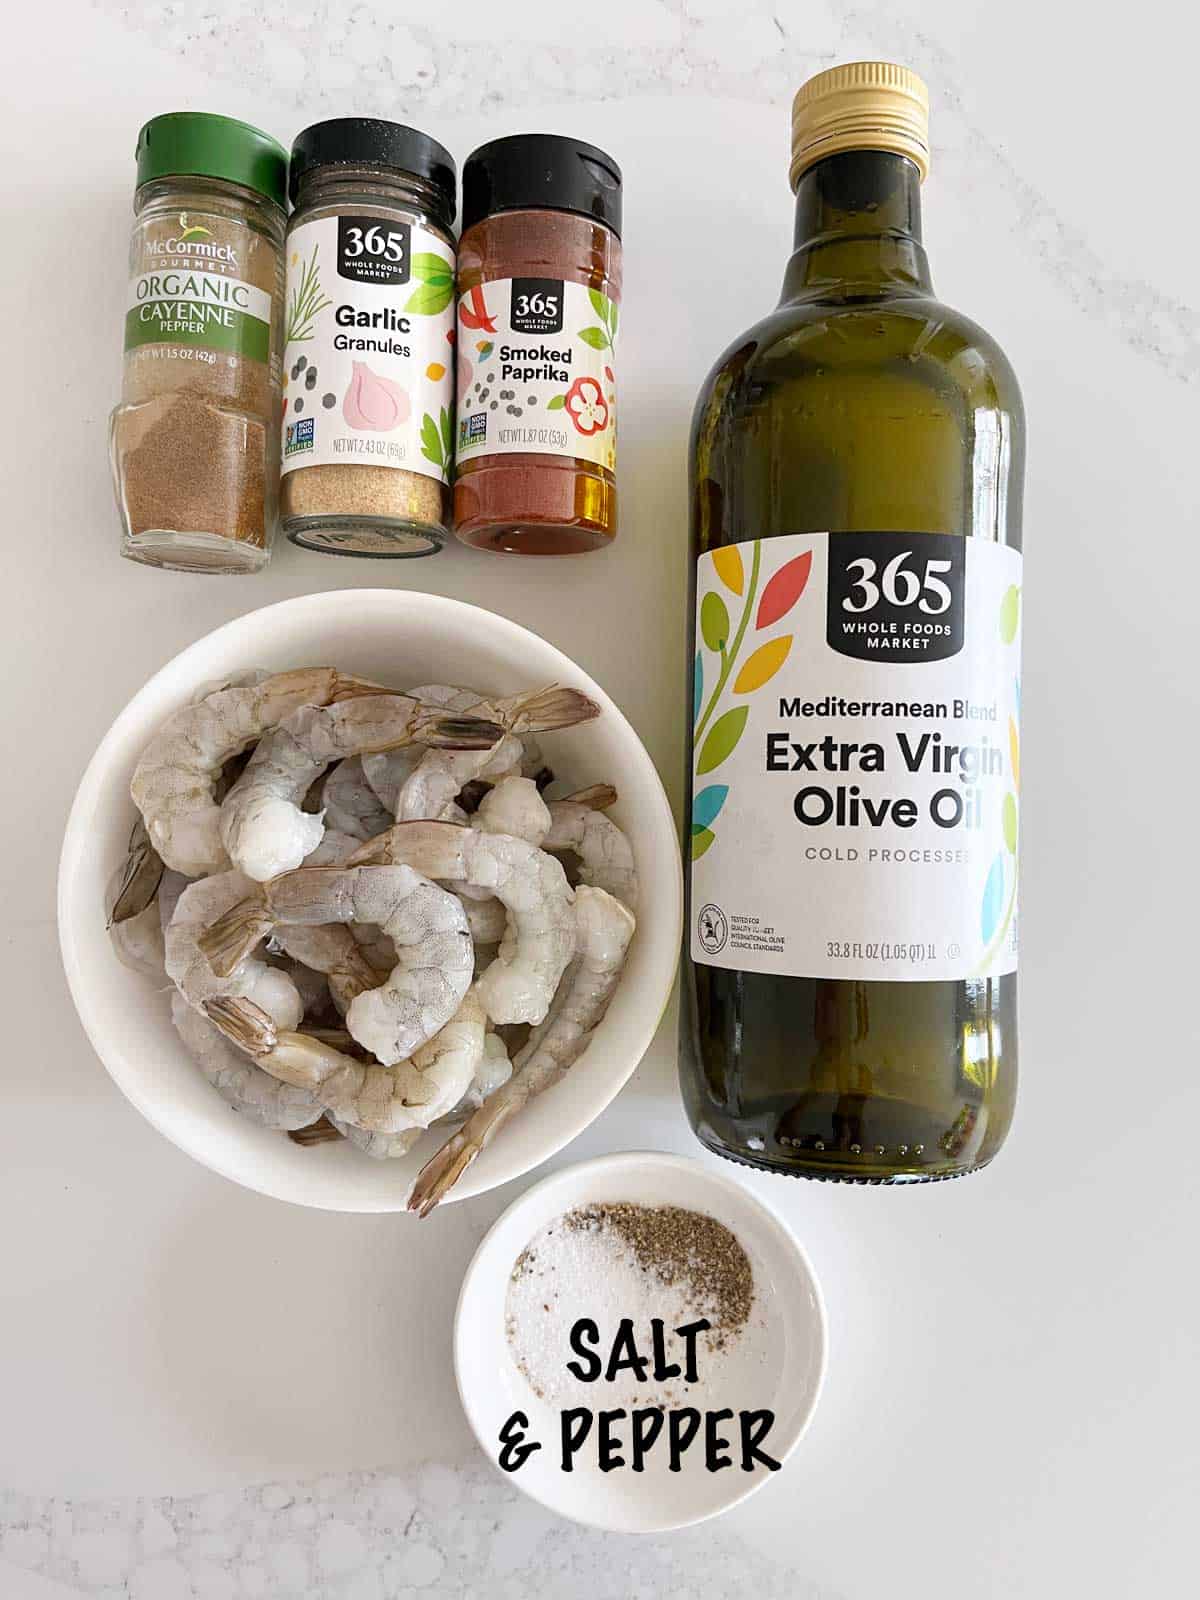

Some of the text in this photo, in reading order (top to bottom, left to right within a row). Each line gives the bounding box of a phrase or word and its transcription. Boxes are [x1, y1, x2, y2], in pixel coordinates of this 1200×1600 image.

[145, 238, 238, 265] McCormick
[344, 226, 403, 262] 365
[344, 261, 403, 274] WHOLE FOODS
[356, 268, 391, 279] MARKET
[136, 274, 250, 308] ORGANIC
[139, 301, 236, 328] CAYENNE
[515, 292, 558, 317] 365
[160, 320, 206, 334] PEPPER
[335, 305, 411, 334] Garlic
[179, 349, 193, 361] OZ
[334, 334, 411, 358] Granules
[499, 345, 572, 364] Smoked
[502, 365, 569, 383] Paprika
[842, 551, 953, 615] 365
[842, 623, 952, 636] WHOLE FOODS
[867, 637, 930, 649] MARKET
[779, 697, 997, 721] Mediterranean Blend
[766, 732, 1004, 785] Extra Virgin
[793, 786, 982, 830] Olive Oil
[805, 848, 970, 863] COLD PROCESSE
[826, 942, 936, 962] 33.8 FL OZ (1.05 QT) 1L
